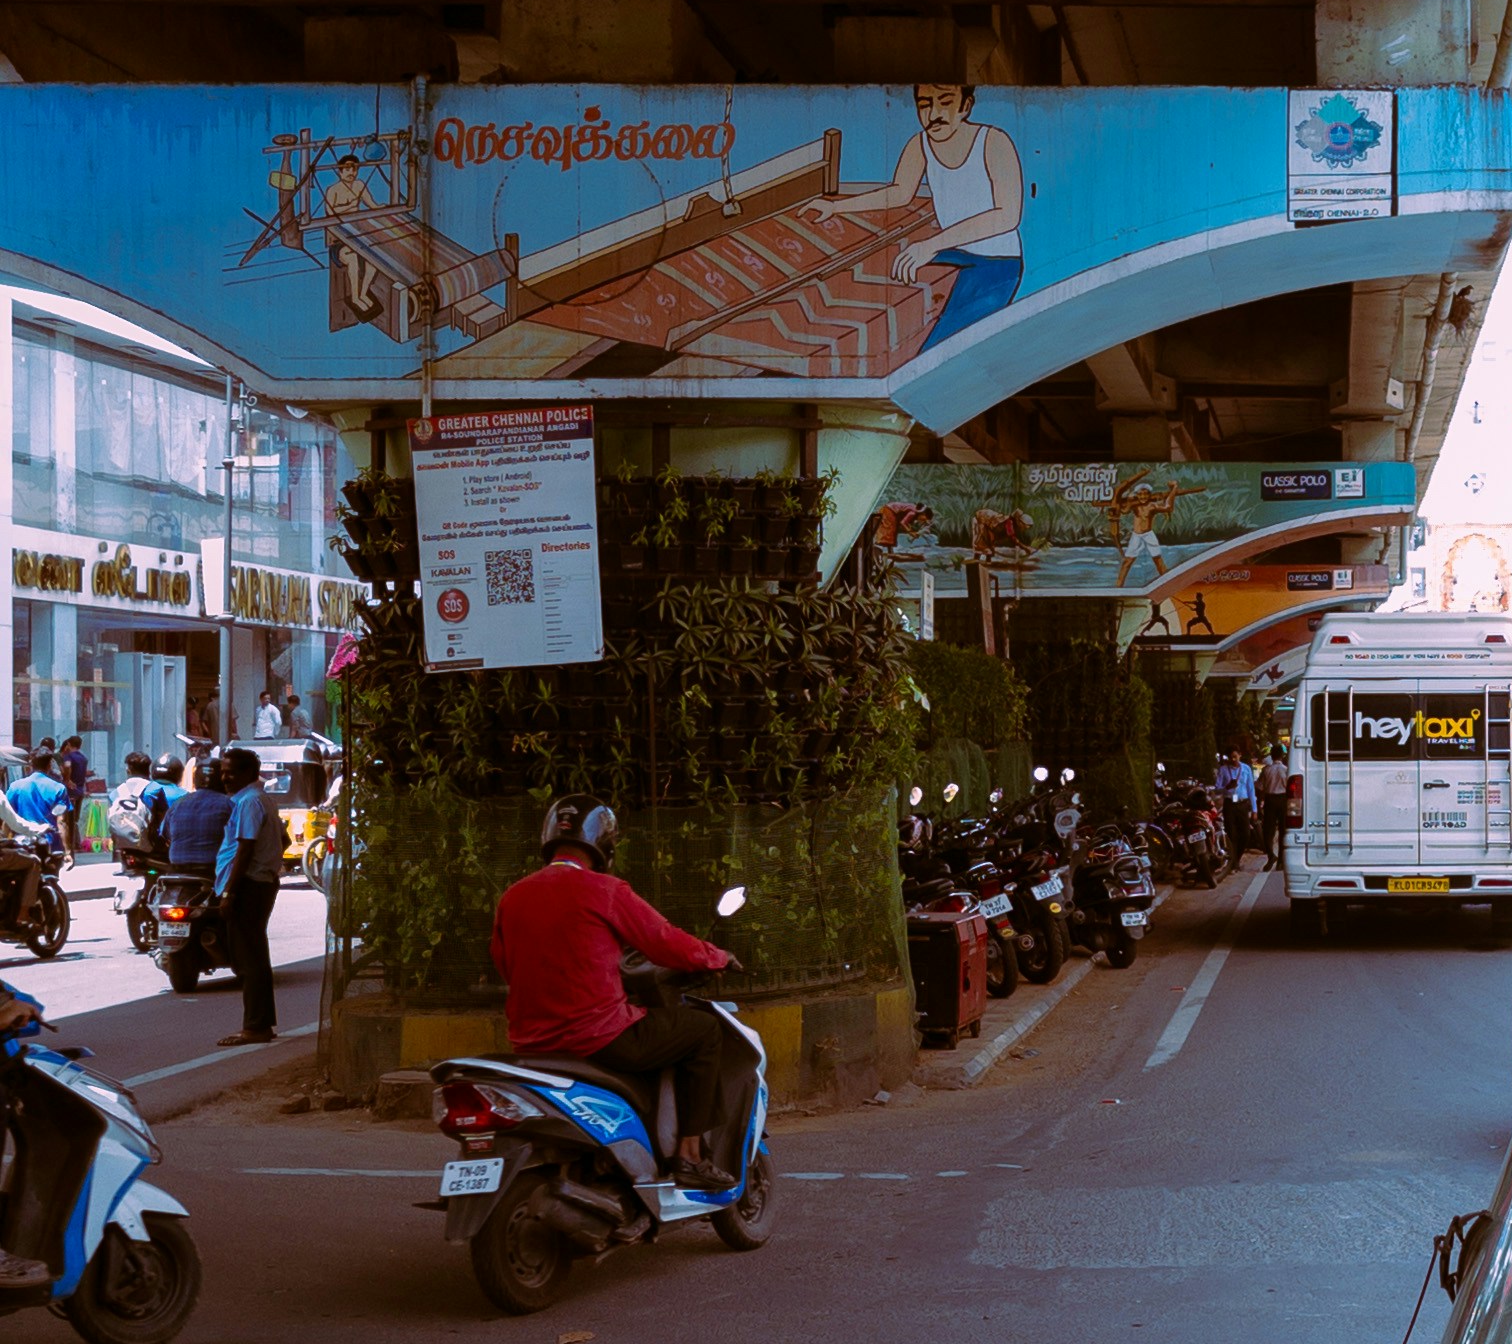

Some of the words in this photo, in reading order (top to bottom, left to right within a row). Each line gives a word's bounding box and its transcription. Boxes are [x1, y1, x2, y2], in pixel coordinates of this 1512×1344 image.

[434, 105, 737, 172] நெசவுக்கலை
[1346, 187, 1386, 195] CORPORATION
[438, 416, 488, 431] GREATER
[493, 413, 543, 428] CHENNAI
[546, 407, 588, 422] POLICE
[476, 436, 505, 446] POLICE
[507, 434, 544, 444] STATION
[451, 459, 475, 469] Mobile
[475, 459, 490, 469] App
[468, 474, 482, 485] Play
[1028, 463, 1118, 493] தமிழனின்
[1263, 475, 1298, 487] CLASSIC
[1300, 474, 1327, 486] POLO
[470, 486, 492, 495] Search
[471, 497, 490, 506] Install
[499, 496, 520, 505] shown
[452, 520, 468, 530] Code
[541, 541, 591, 553] Directories
[438, 550, 455, 560] SOS
[431, 566, 471, 578] KAVALAN
[1288, 574, 1310, 583] CLASSIC
[1311, 573, 1329, 582] POLO
[444, 599, 463, 613] SOS
[1355, 709, 1480, 746] heytaxi
[1422, 821, 1440, 829] OFF
[1441, 821, 1467, 829] ROAD
[459, 1165, 488, 1177] TN-09
